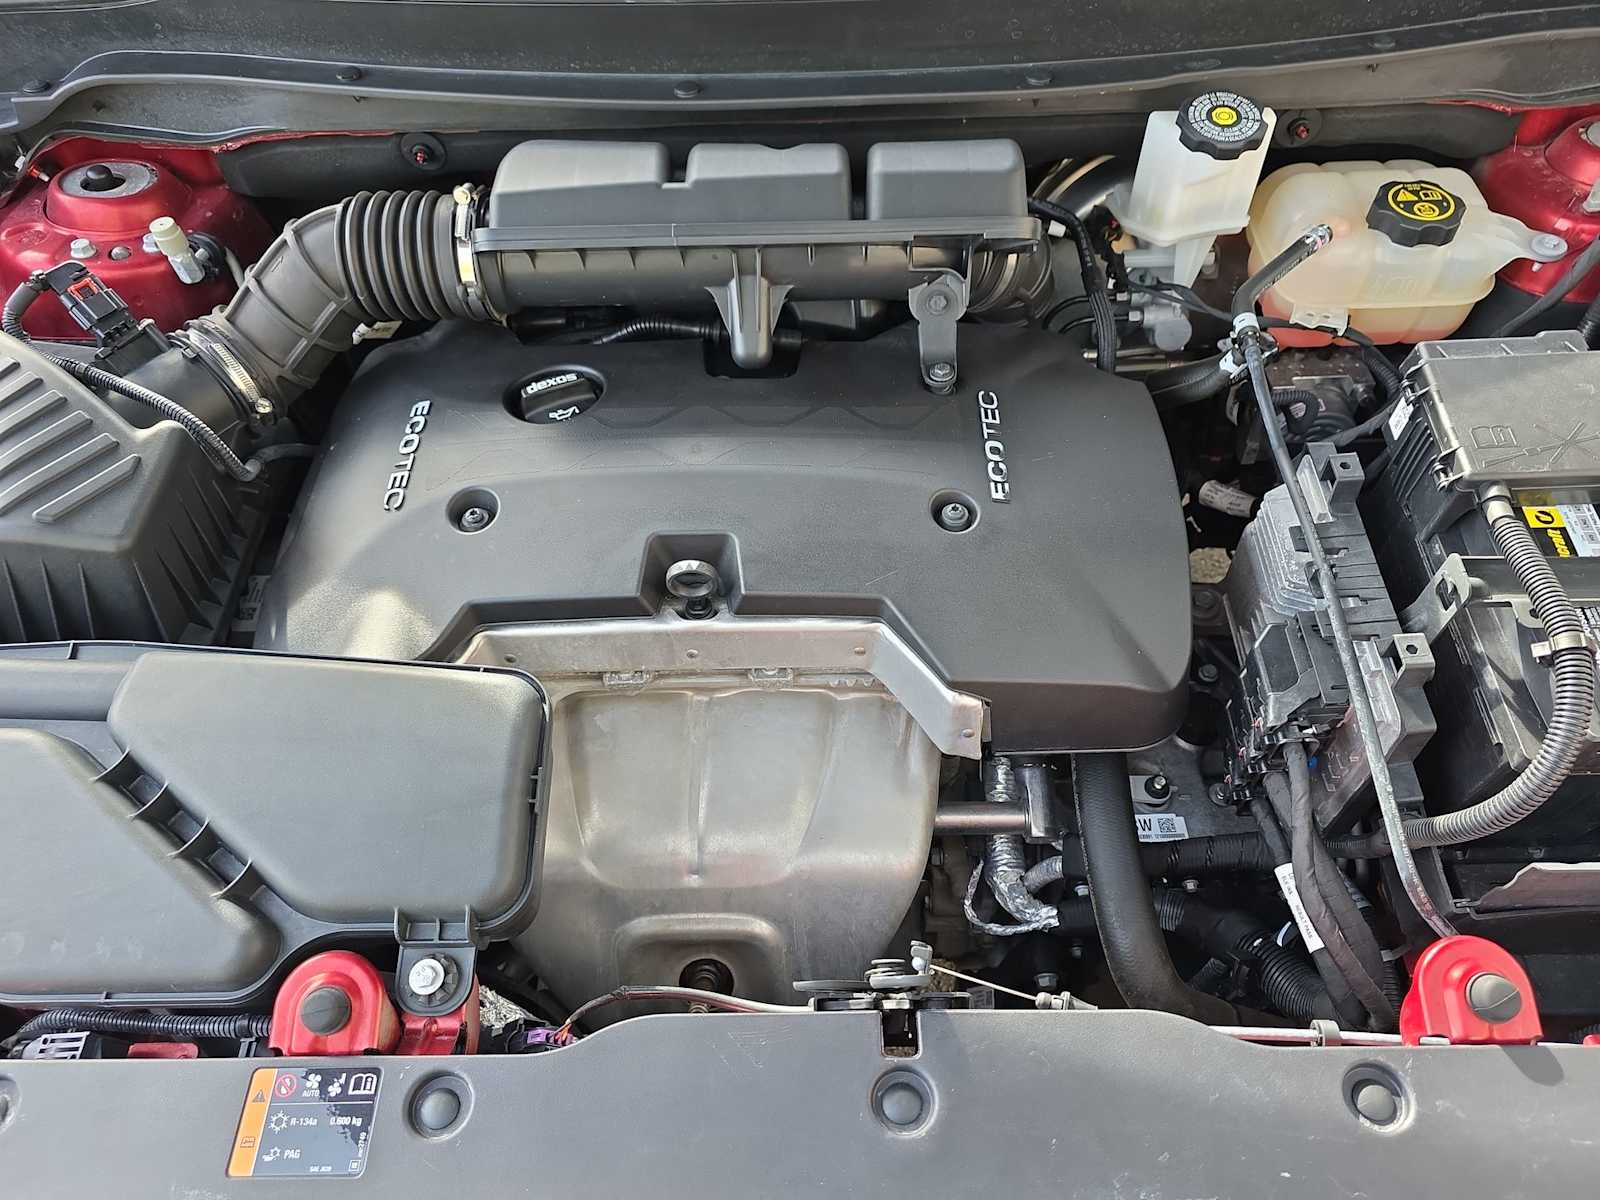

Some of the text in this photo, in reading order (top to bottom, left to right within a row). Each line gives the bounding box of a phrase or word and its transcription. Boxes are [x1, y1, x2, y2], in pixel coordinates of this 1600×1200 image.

[526, 373, 578, 394] dexos
[383, 400, 431, 511] ECOTEC
[978, 390, 1010, 504] ECOTEC
[1138, 818, 1153, 832] W
[290, 1117, 318, 1126] R-134a
[351, 1116, 363, 1127] kg
[283, 1149, 301, 1160] PAG
